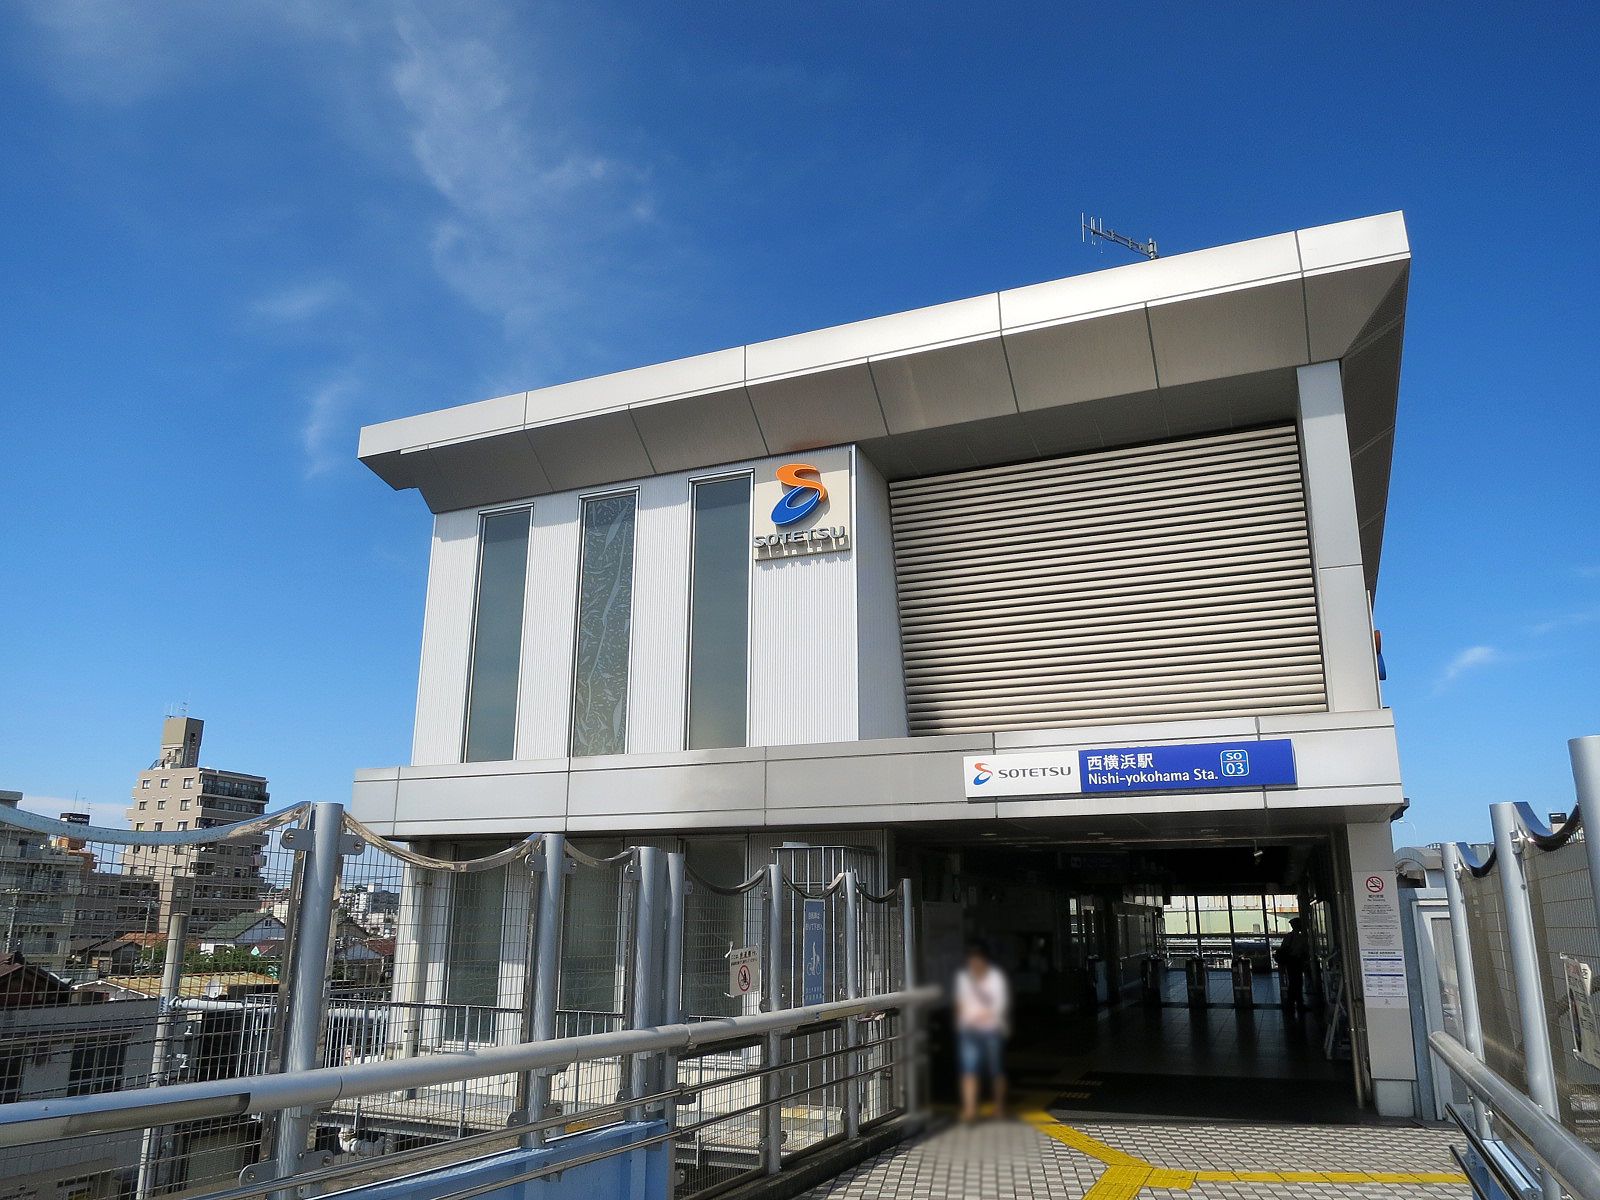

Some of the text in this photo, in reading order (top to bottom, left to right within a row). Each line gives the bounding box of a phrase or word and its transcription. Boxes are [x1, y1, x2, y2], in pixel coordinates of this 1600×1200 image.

[753, 526, 845, 548] SOTETSU
[1087, 752, 1153, 771] 西横浜駅
[1225, 752, 1243, 761] SO
[998, 766, 1071, 779] SOTETSU
[1225, 762, 1245, 775] 03
[1088, 768, 1219, 787] Nishi-yokohama Sta.
